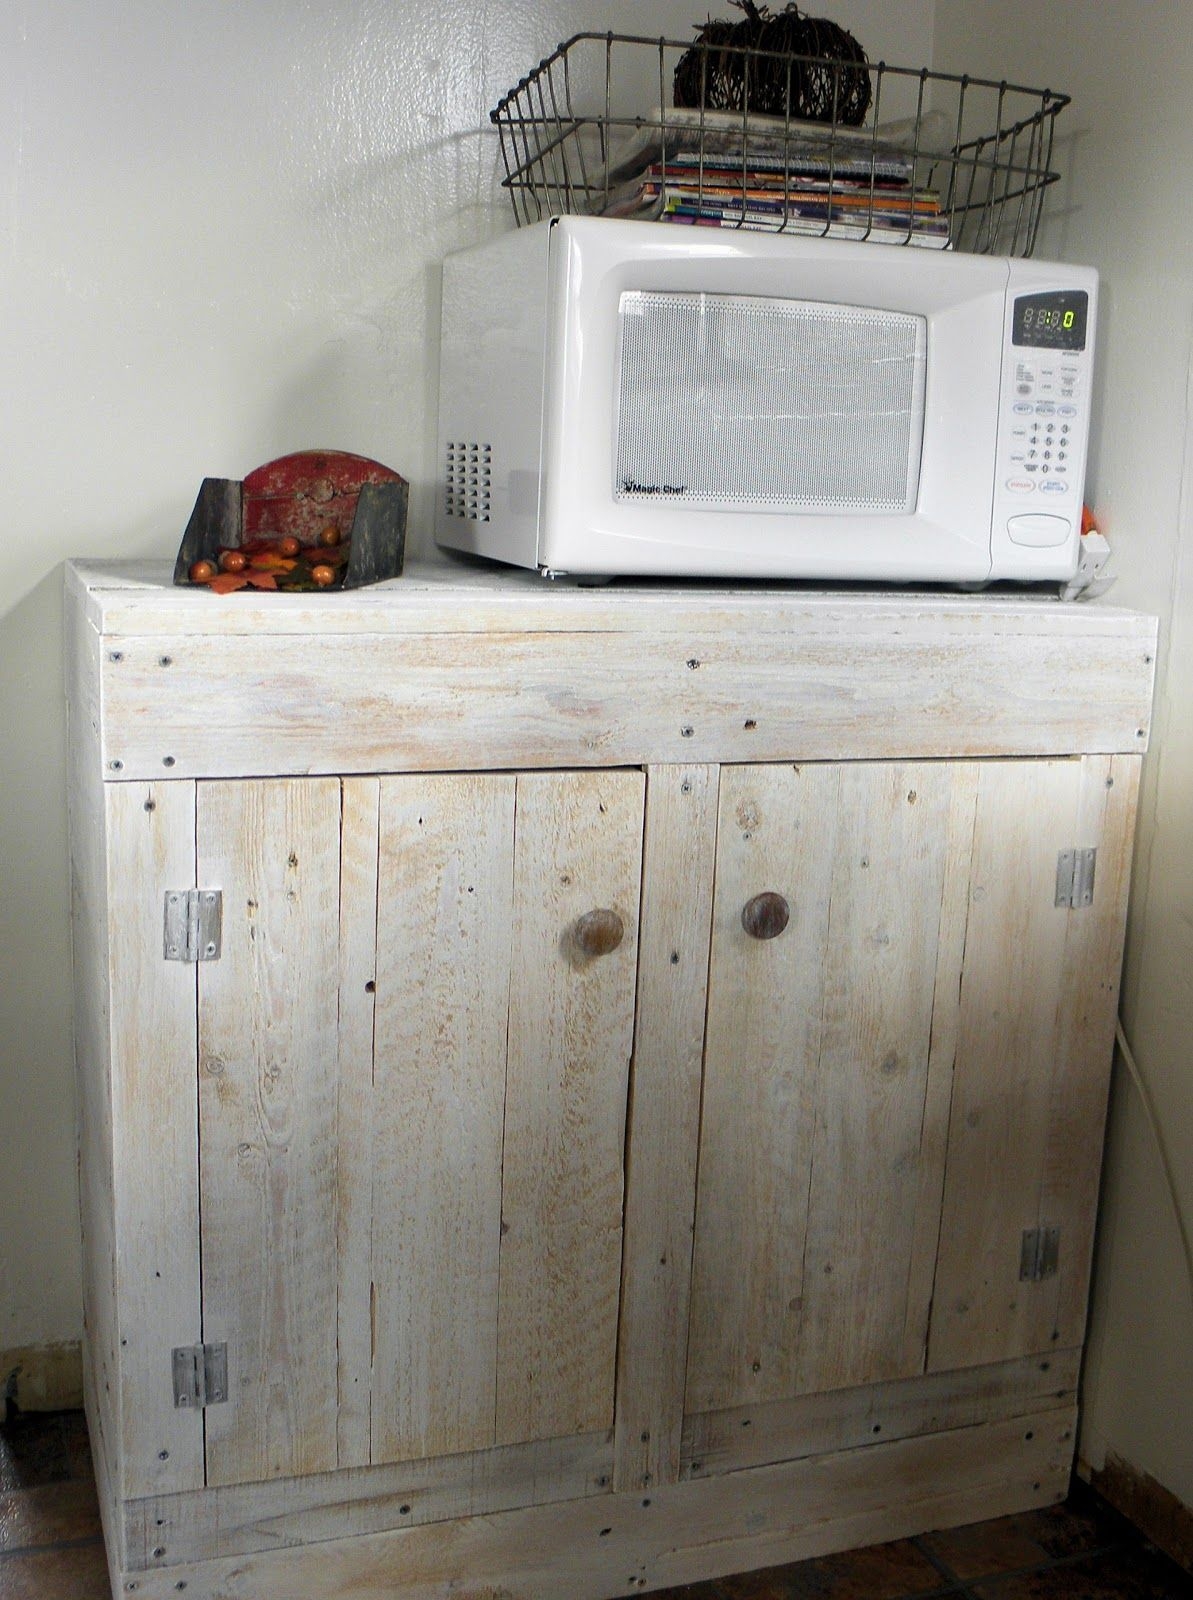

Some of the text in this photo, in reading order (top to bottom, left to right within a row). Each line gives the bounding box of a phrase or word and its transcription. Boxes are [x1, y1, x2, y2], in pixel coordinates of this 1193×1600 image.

[1047, 423, 1054, 433] 2
[1062, 424, 1069, 434] 3
[1030, 436, 1067, 447] 4 5 6
[1030, 449, 1065, 461] 7 8 9
[1042, 463, 1049, 473] 0
[632, 484, 684, 494] Magic Chef
